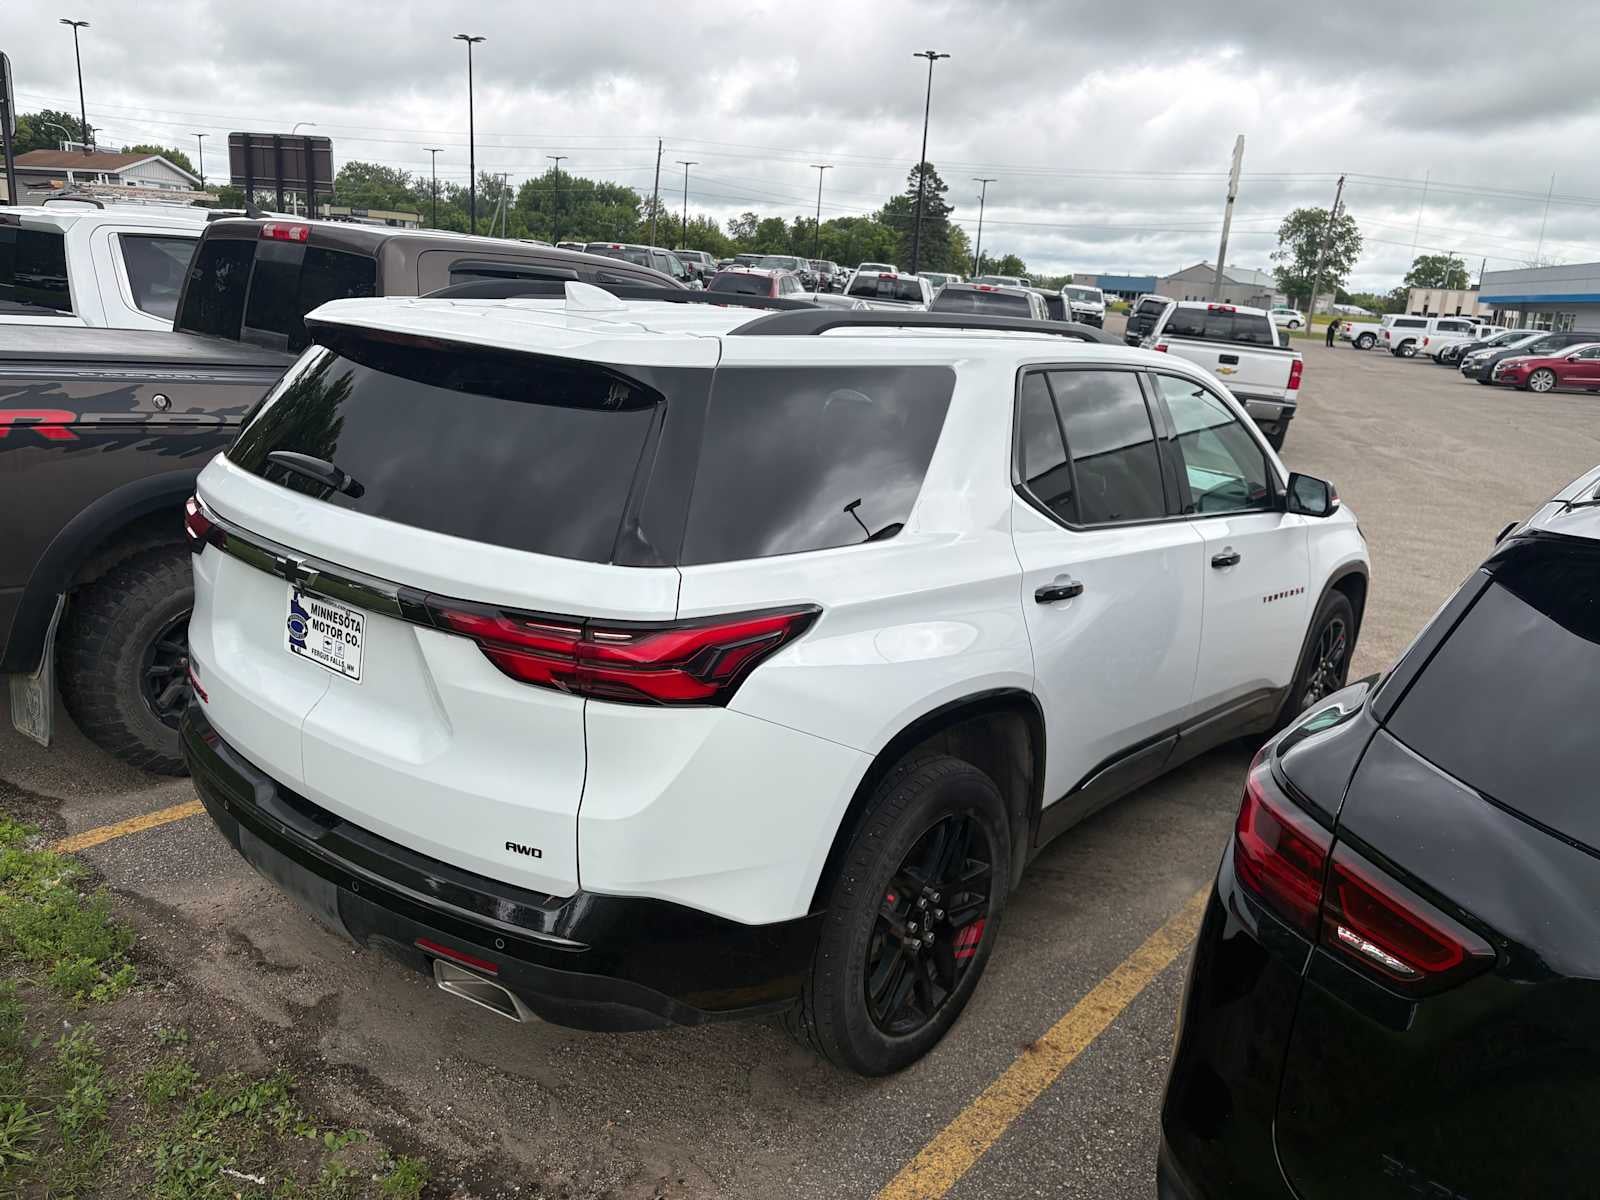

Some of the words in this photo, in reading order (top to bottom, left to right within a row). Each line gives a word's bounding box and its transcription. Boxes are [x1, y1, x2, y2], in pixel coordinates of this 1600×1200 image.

[311, 603, 360, 633] MINNESOTA
[312, 618, 342, 640] MOTOR
[345, 632, 359, 648] CO.
[311, 648, 329, 661] FERGUS
[506, 841, 542, 858] AWD
